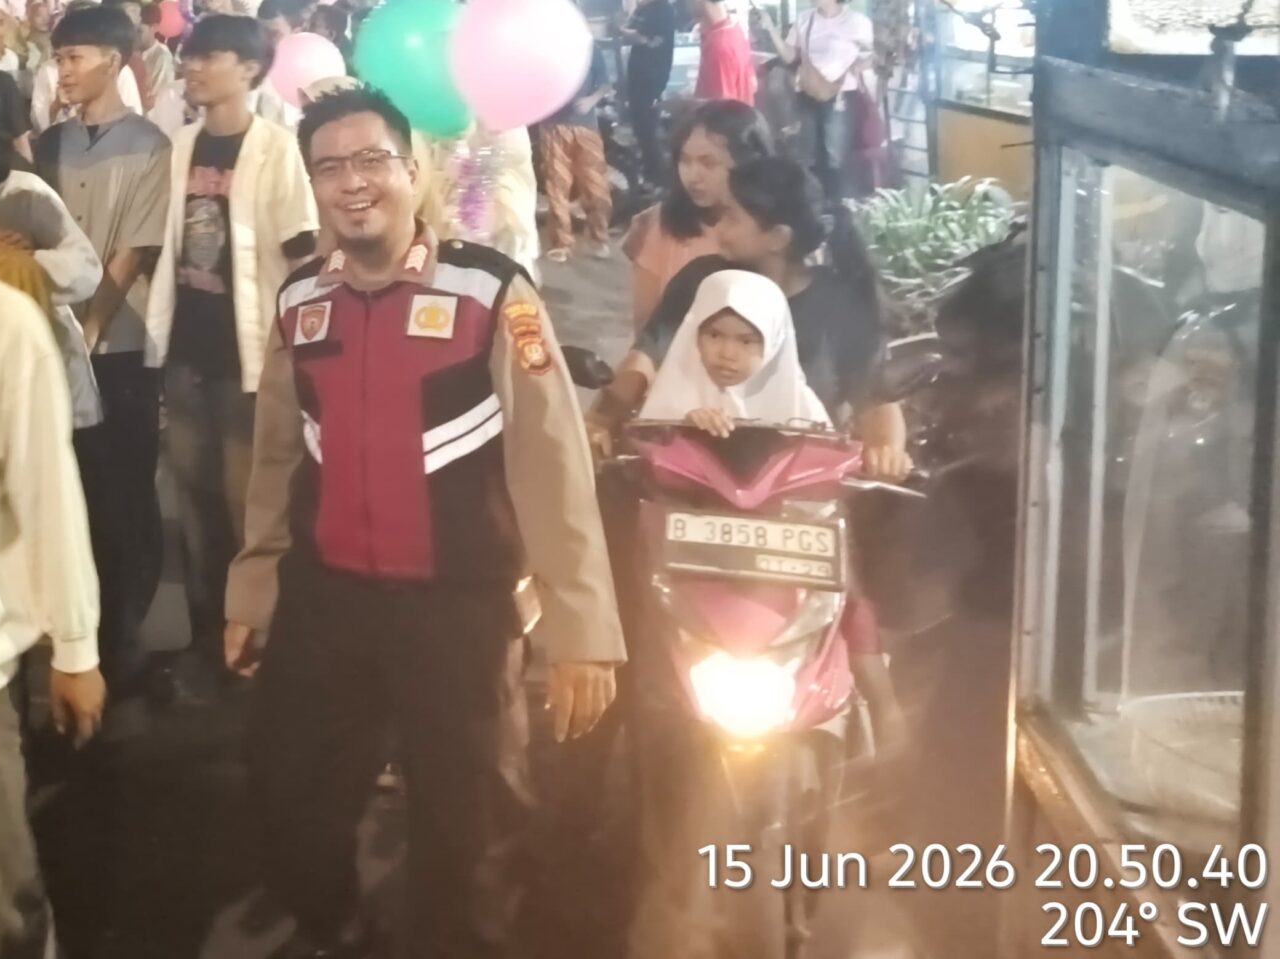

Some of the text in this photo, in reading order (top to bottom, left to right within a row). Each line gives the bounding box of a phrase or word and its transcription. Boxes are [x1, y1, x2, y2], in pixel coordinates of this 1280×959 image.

[673, 518, 830, 553] B 3858 PGS
